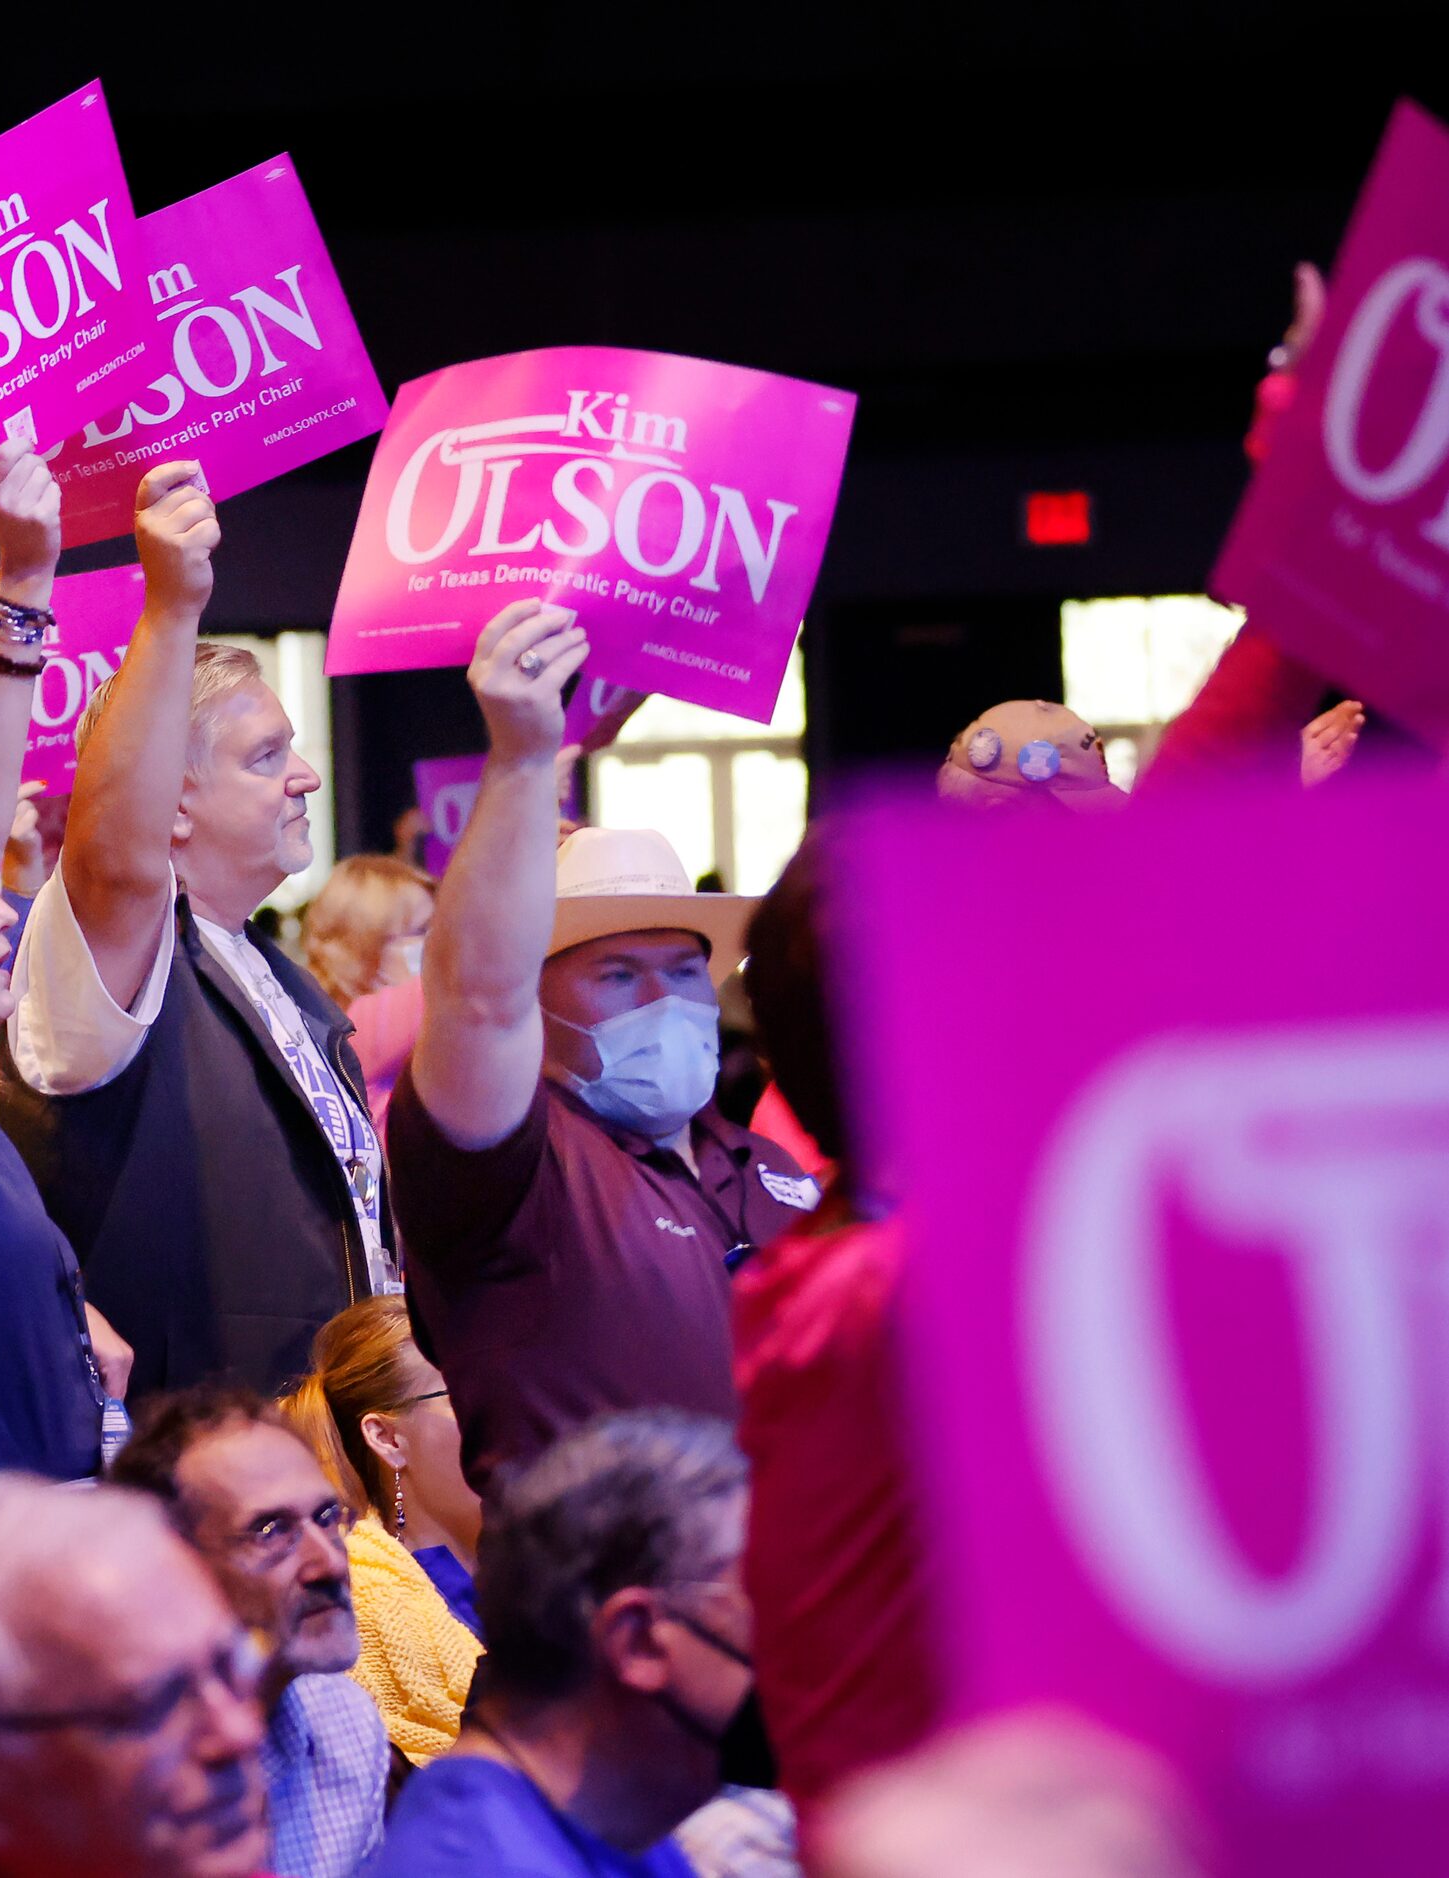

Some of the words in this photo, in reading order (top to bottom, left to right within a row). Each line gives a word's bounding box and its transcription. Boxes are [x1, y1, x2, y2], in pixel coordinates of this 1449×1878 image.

[39, 340, 73, 373] Party
[73, 318, 108, 351] Chair
[75, 341, 146, 393] KIMOLSONTX.COM
[72, 457, 116, 479] Texas
[115, 418, 210, 467] Democratic
[211, 399, 257, 431] Party
[258, 375, 304, 407] Chair
[263, 396, 358, 447] KIMOLSONTX.COM
[559, 389, 687, 454] Kim
[384, 425, 800, 605] OLSON
[407, 573, 435, 593] for
[439, 568, 490, 589] Texas
[494, 563, 611, 598] Democratic
[614, 581, 667, 616] Party
[670, 596, 721, 627] Chair
